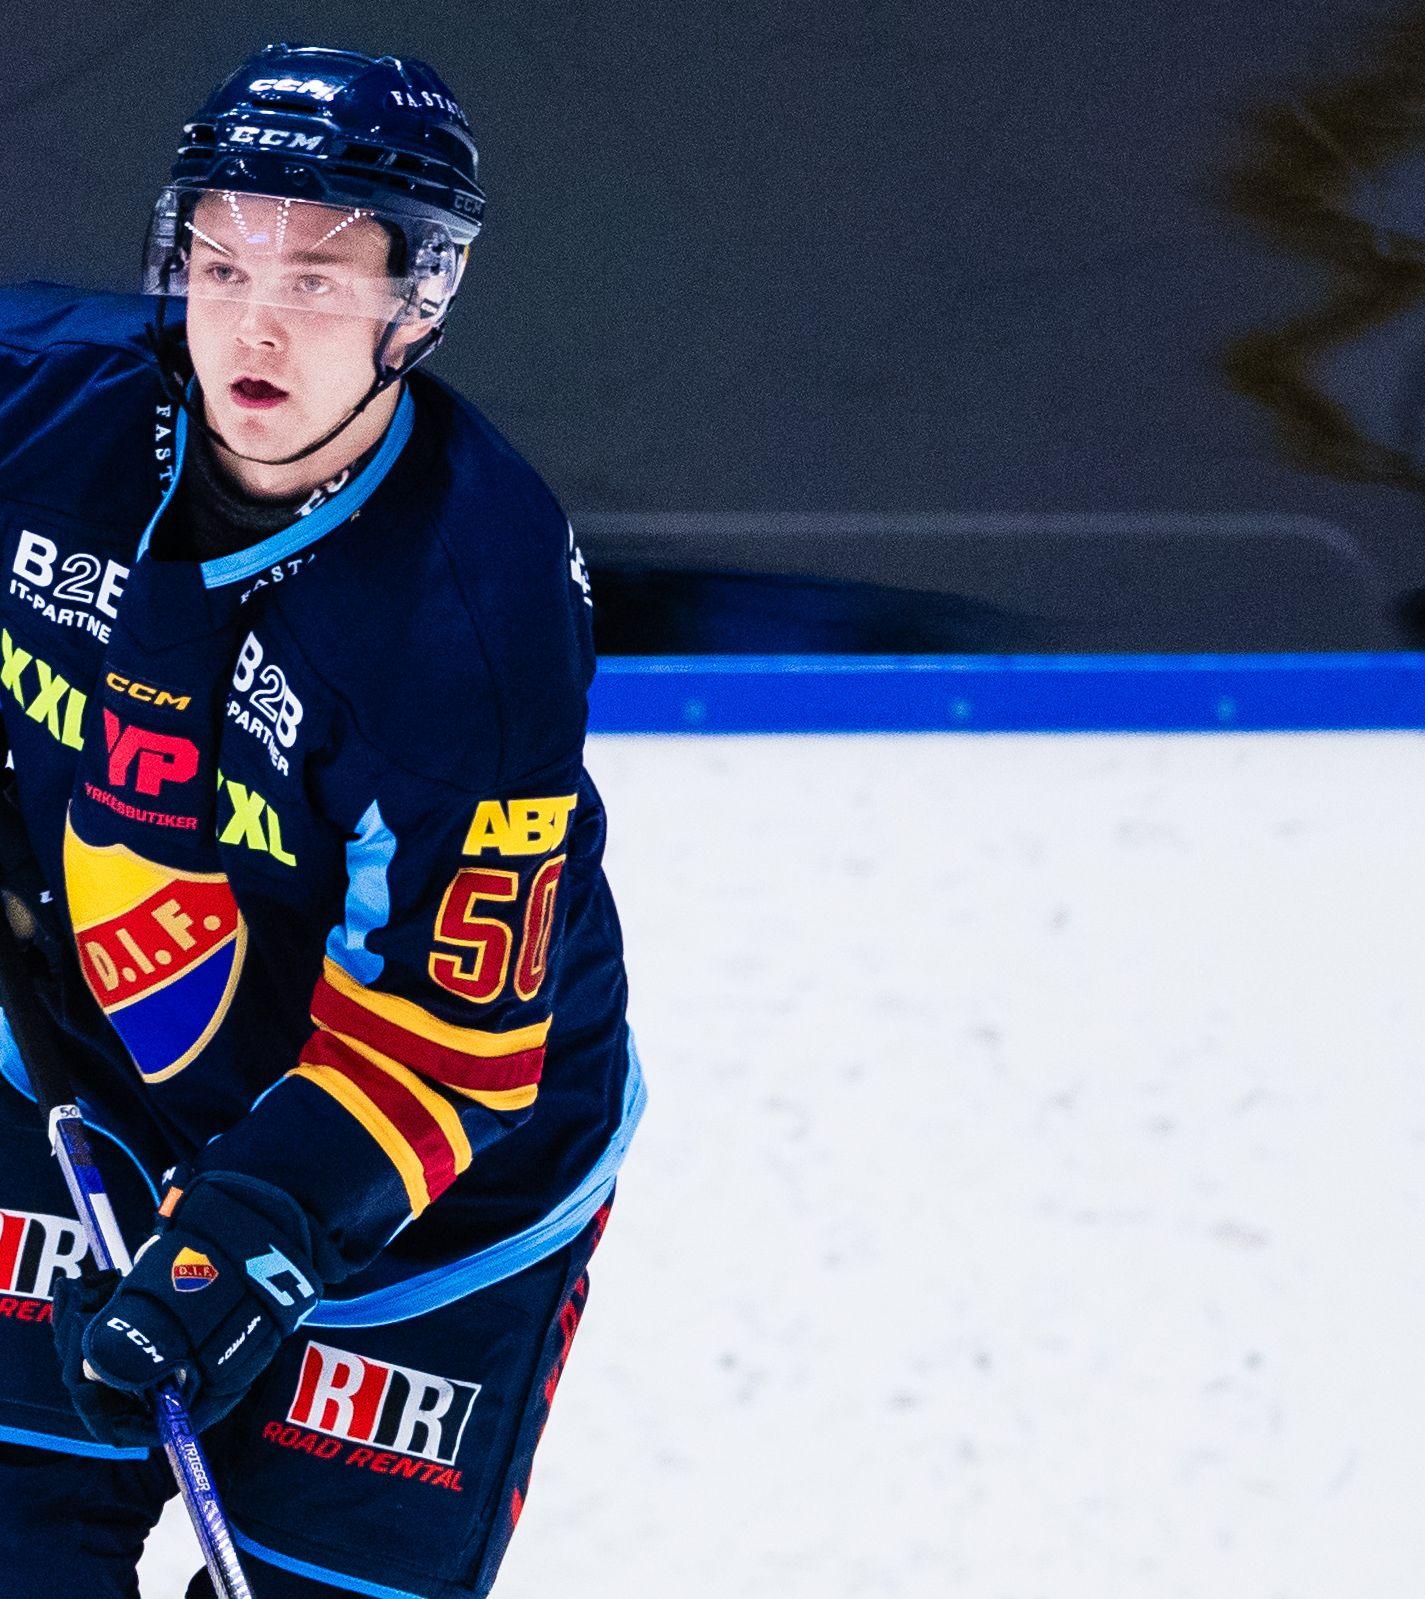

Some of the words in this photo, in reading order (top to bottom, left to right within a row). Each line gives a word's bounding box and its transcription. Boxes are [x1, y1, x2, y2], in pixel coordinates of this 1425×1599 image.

[249, 78, 343, 101] CCM
[229, 125, 324, 151] CCM
[155, 404, 173, 497] FAST
[10, 579, 112, 645] IT-PARTNE
[239, 554, 316, 604] FAST
[0, 627, 87, 751] XXL
[106, 671, 192, 711] CCM
[232, 631, 304, 748] B2B
[103, 706, 200, 796] YP
[226, 701, 289, 777] -PARTNER
[84, 781, 199, 831] YRKESBUTIKER
[84, 898, 222, 993] D.I.F.
[427, 853, 567, 1004] 50
[106, 1316, 165, 1364] CCM
[183, 1440, 211, 1492] TRIGGER
[262, 1419, 343, 1460] ROAD
[345, 1448, 464, 1492] RENTAL
